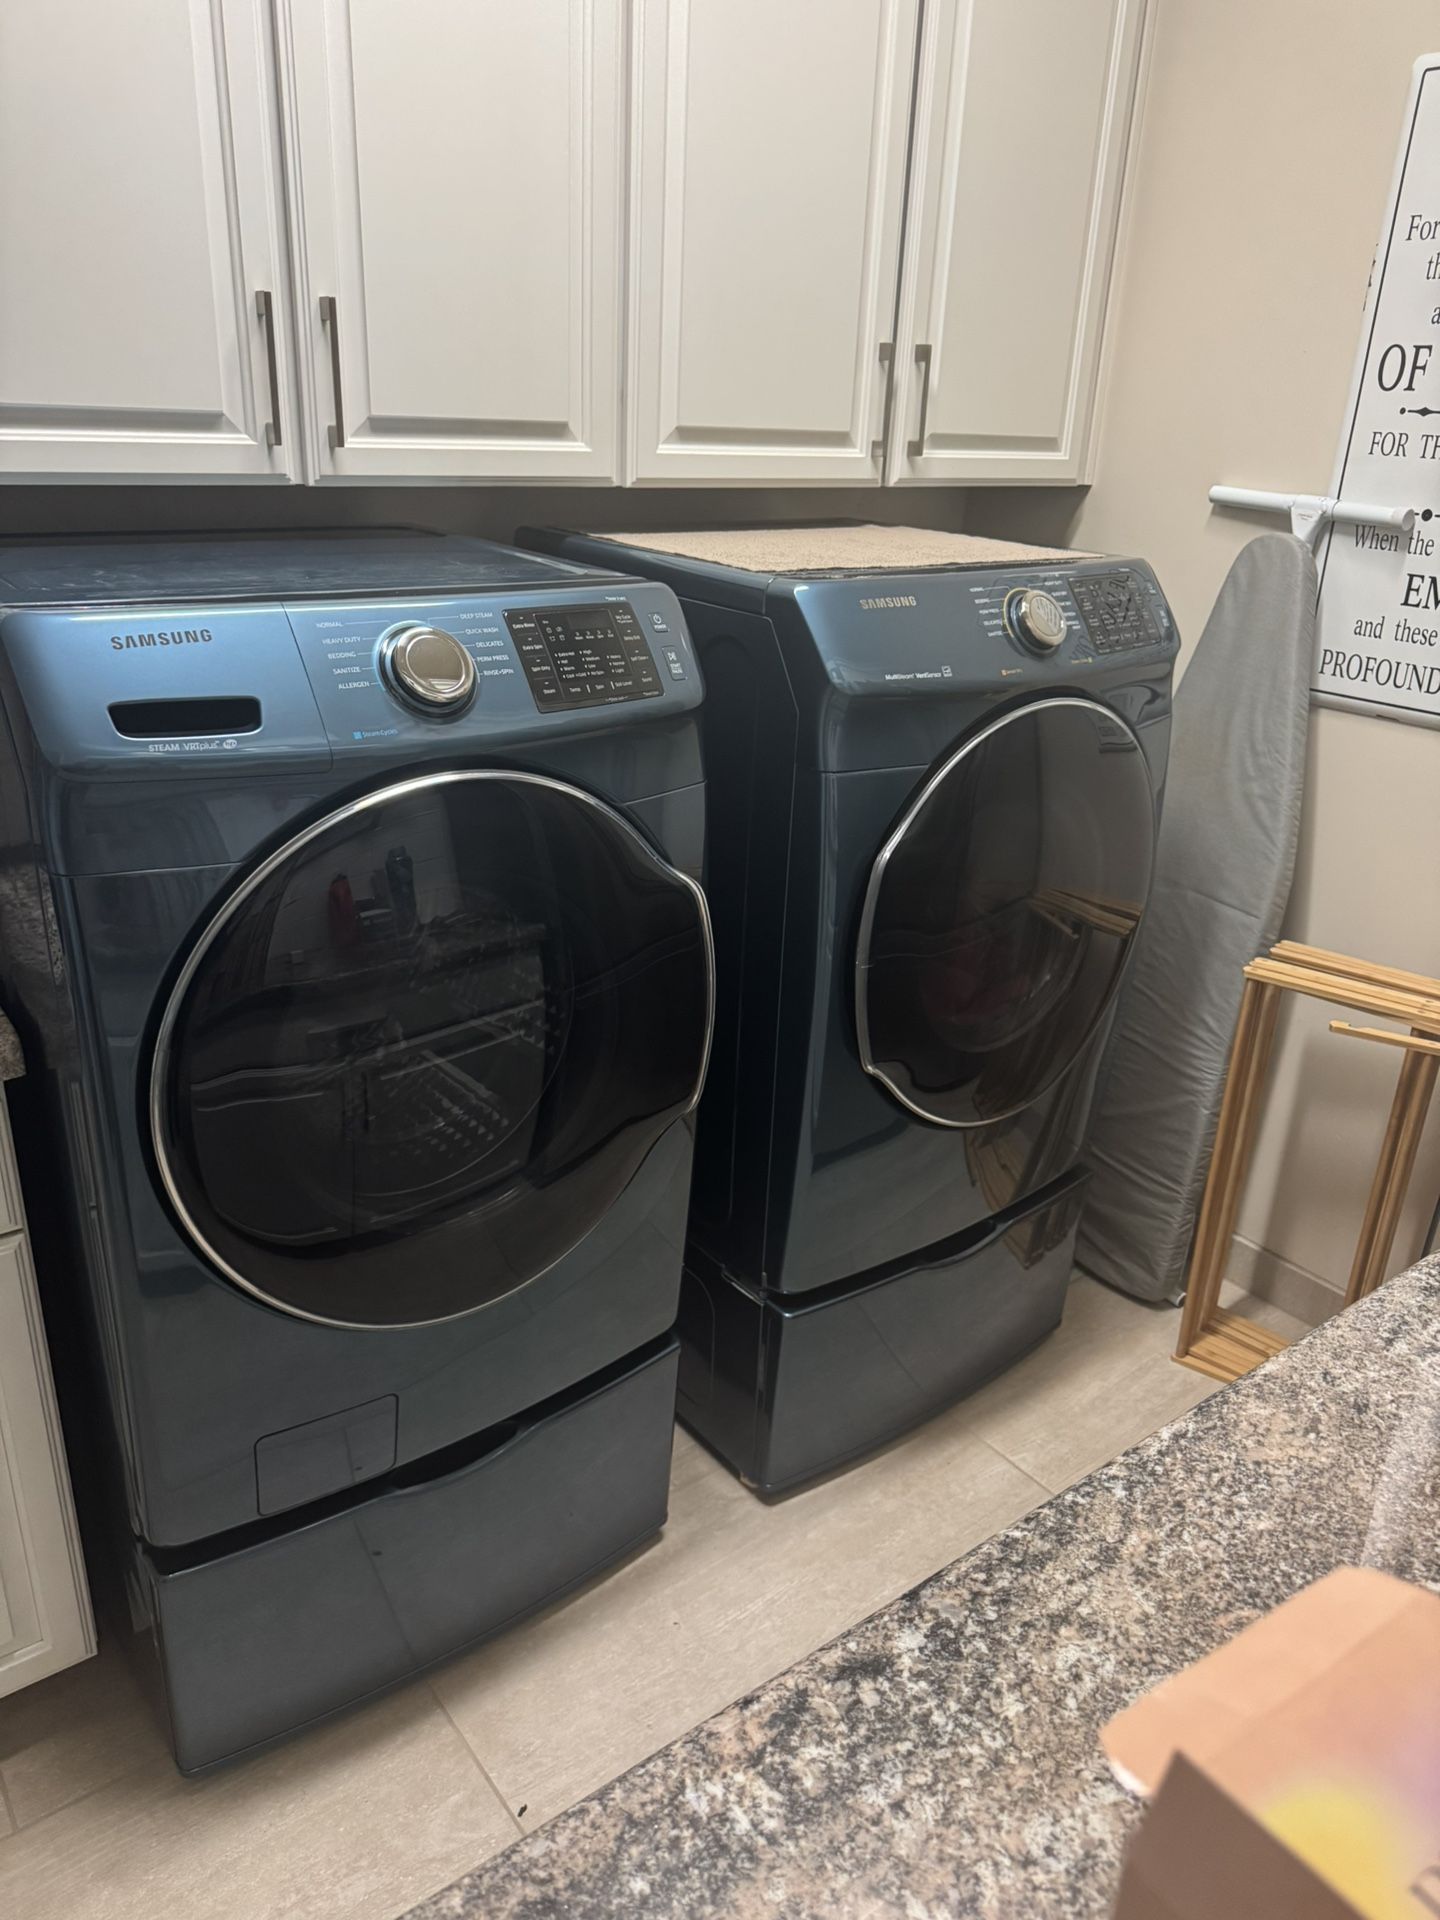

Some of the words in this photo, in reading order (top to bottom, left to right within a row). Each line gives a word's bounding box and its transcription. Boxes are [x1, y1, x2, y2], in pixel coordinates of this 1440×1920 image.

[1404, 214, 1440, 241] For
[1377, 343, 1433, 392] OF
[1368, 431, 1409, 458] FOR
[1354, 524, 1400, 552] When
[1407, 530, 1435, 557] the
[859, 596, 918, 609] SAMSUNG
[110, 628, 213, 650] SAMSUNG
[1353, 616, 1386, 640] and
[1394, 618, 1439, 647] these
[321, 637, 343, 645] HEAVY
[475, 640, 504, 648] DELICATES
[327, 651, 357, 660] BEDDING
[332, 666, 362, 675] SANITIZE
[1318, 648, 1440, 696] PROFOUND
[338, 681, 370, 690] ALLERGEN
[148, 743, 180, 752] STEAM
